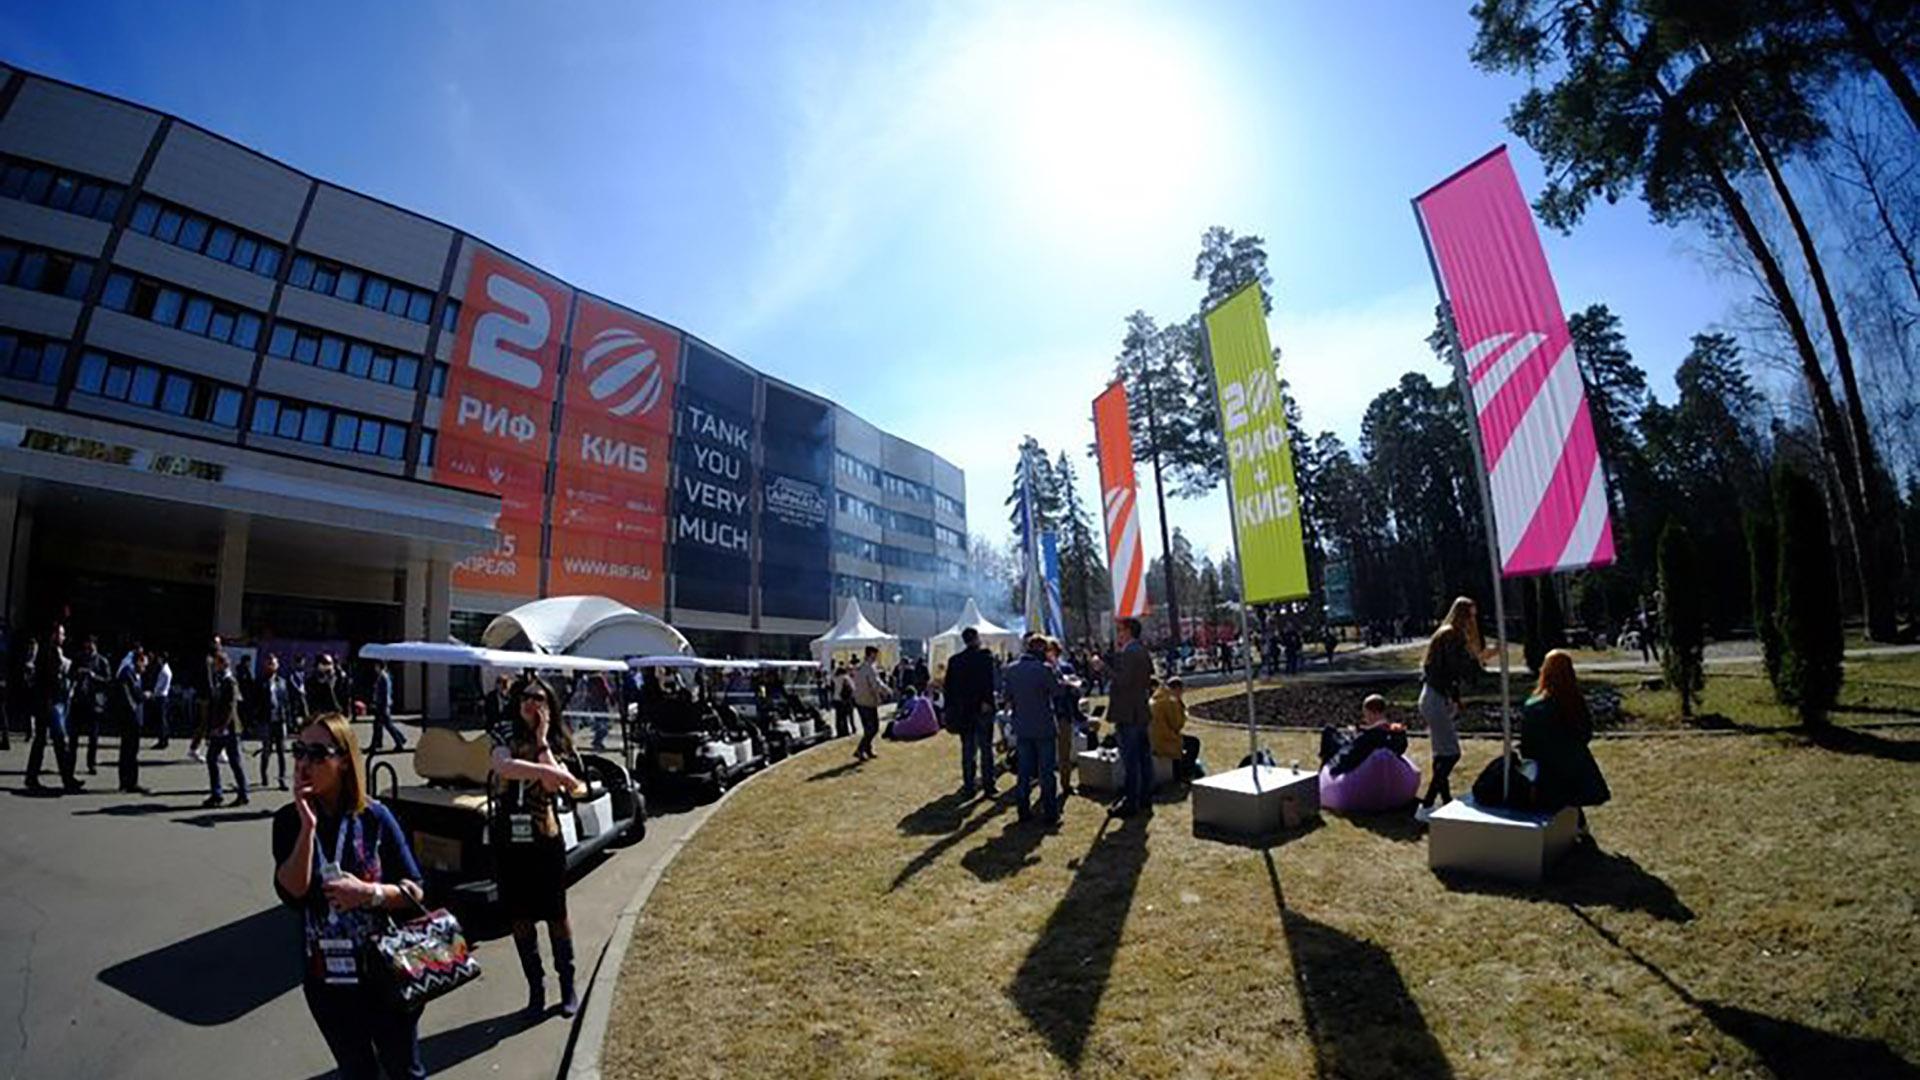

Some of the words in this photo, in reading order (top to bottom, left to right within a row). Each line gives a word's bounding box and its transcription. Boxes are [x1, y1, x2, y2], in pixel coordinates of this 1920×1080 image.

[457, 395, 536, 442] РИФ
[688, 406, 749, 450] TANK
[581, 433, 648, 473] КИБ
[693, 444, 741, 481] YOU
[1229, 422, 1284, 467] РИФ
[684, 476, 748, 516] VERY
[1240, 484, 1293, 526] КИБ
[678, 515, 749, 551] MUCH
[563, 555, 653, 582] WWW.RIF.RU
